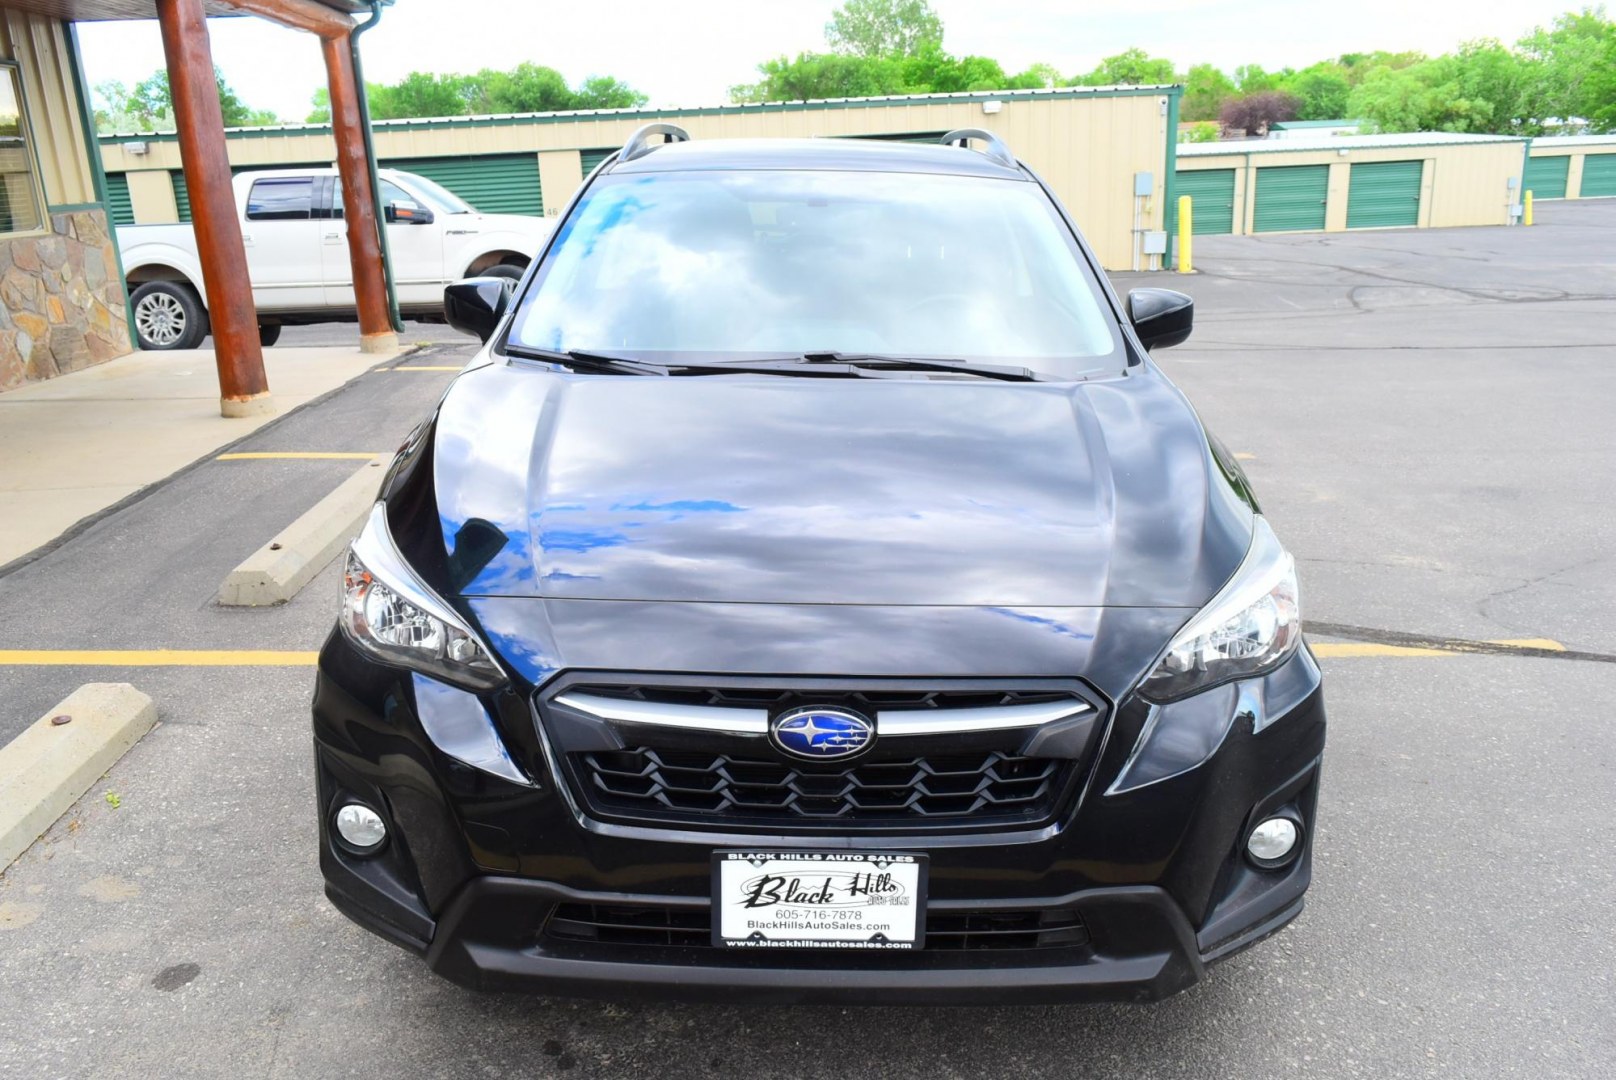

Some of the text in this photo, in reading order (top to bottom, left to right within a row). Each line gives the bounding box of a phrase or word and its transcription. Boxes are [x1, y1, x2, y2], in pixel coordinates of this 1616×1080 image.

[780, 853, 822, 861] HILLS
[867, 855, 914, 863] SALES
[736, 872, 897, 909] Black Hills
[775, 909, 862, 920] 605-716-7878
[747, 920, 891, 931] BlackHillsAutoSales.com
[726, 939, 912, 949] www.blackhillsautosales.com
